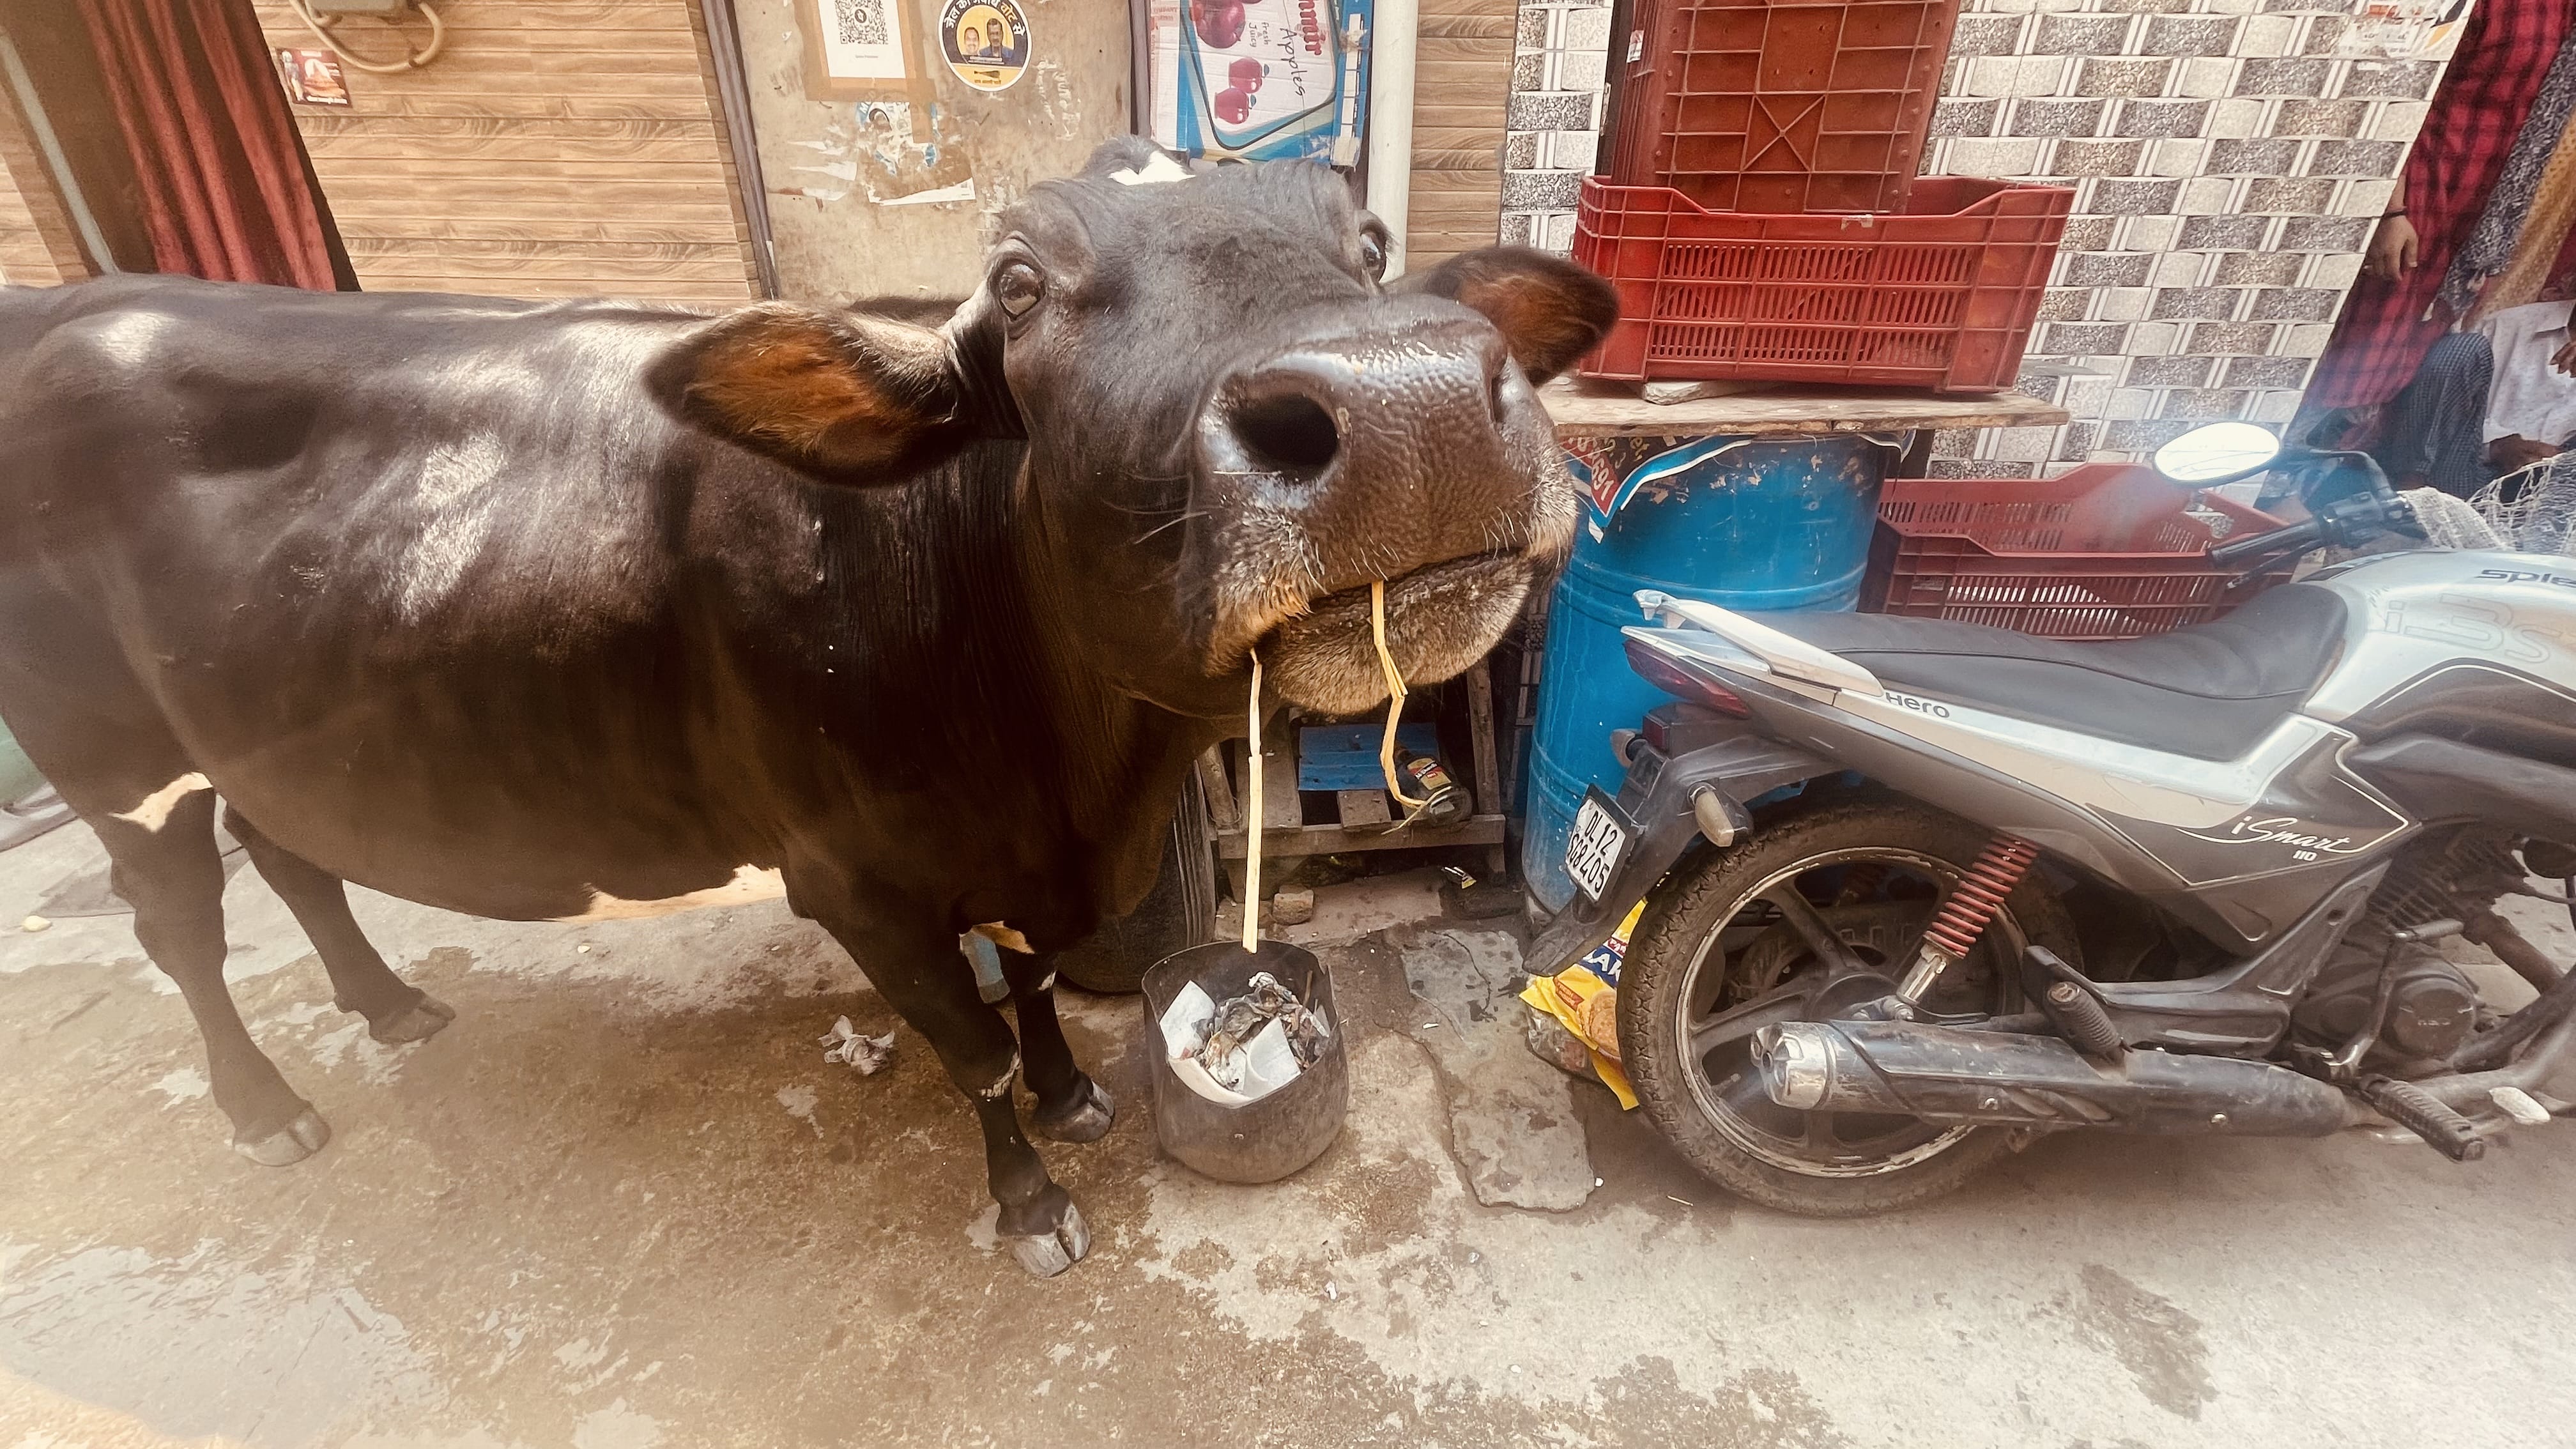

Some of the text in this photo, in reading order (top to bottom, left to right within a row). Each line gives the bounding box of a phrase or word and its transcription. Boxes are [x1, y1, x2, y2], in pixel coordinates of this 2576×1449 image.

[1248, 22, 1257, 47] Juicy
[1277, 27, 1308, 96] Apples
[1885, 692, 1950, 718] Hero
[1595, 823, 1618, 857] 12
[2292, 850, 2318, 862] 110
